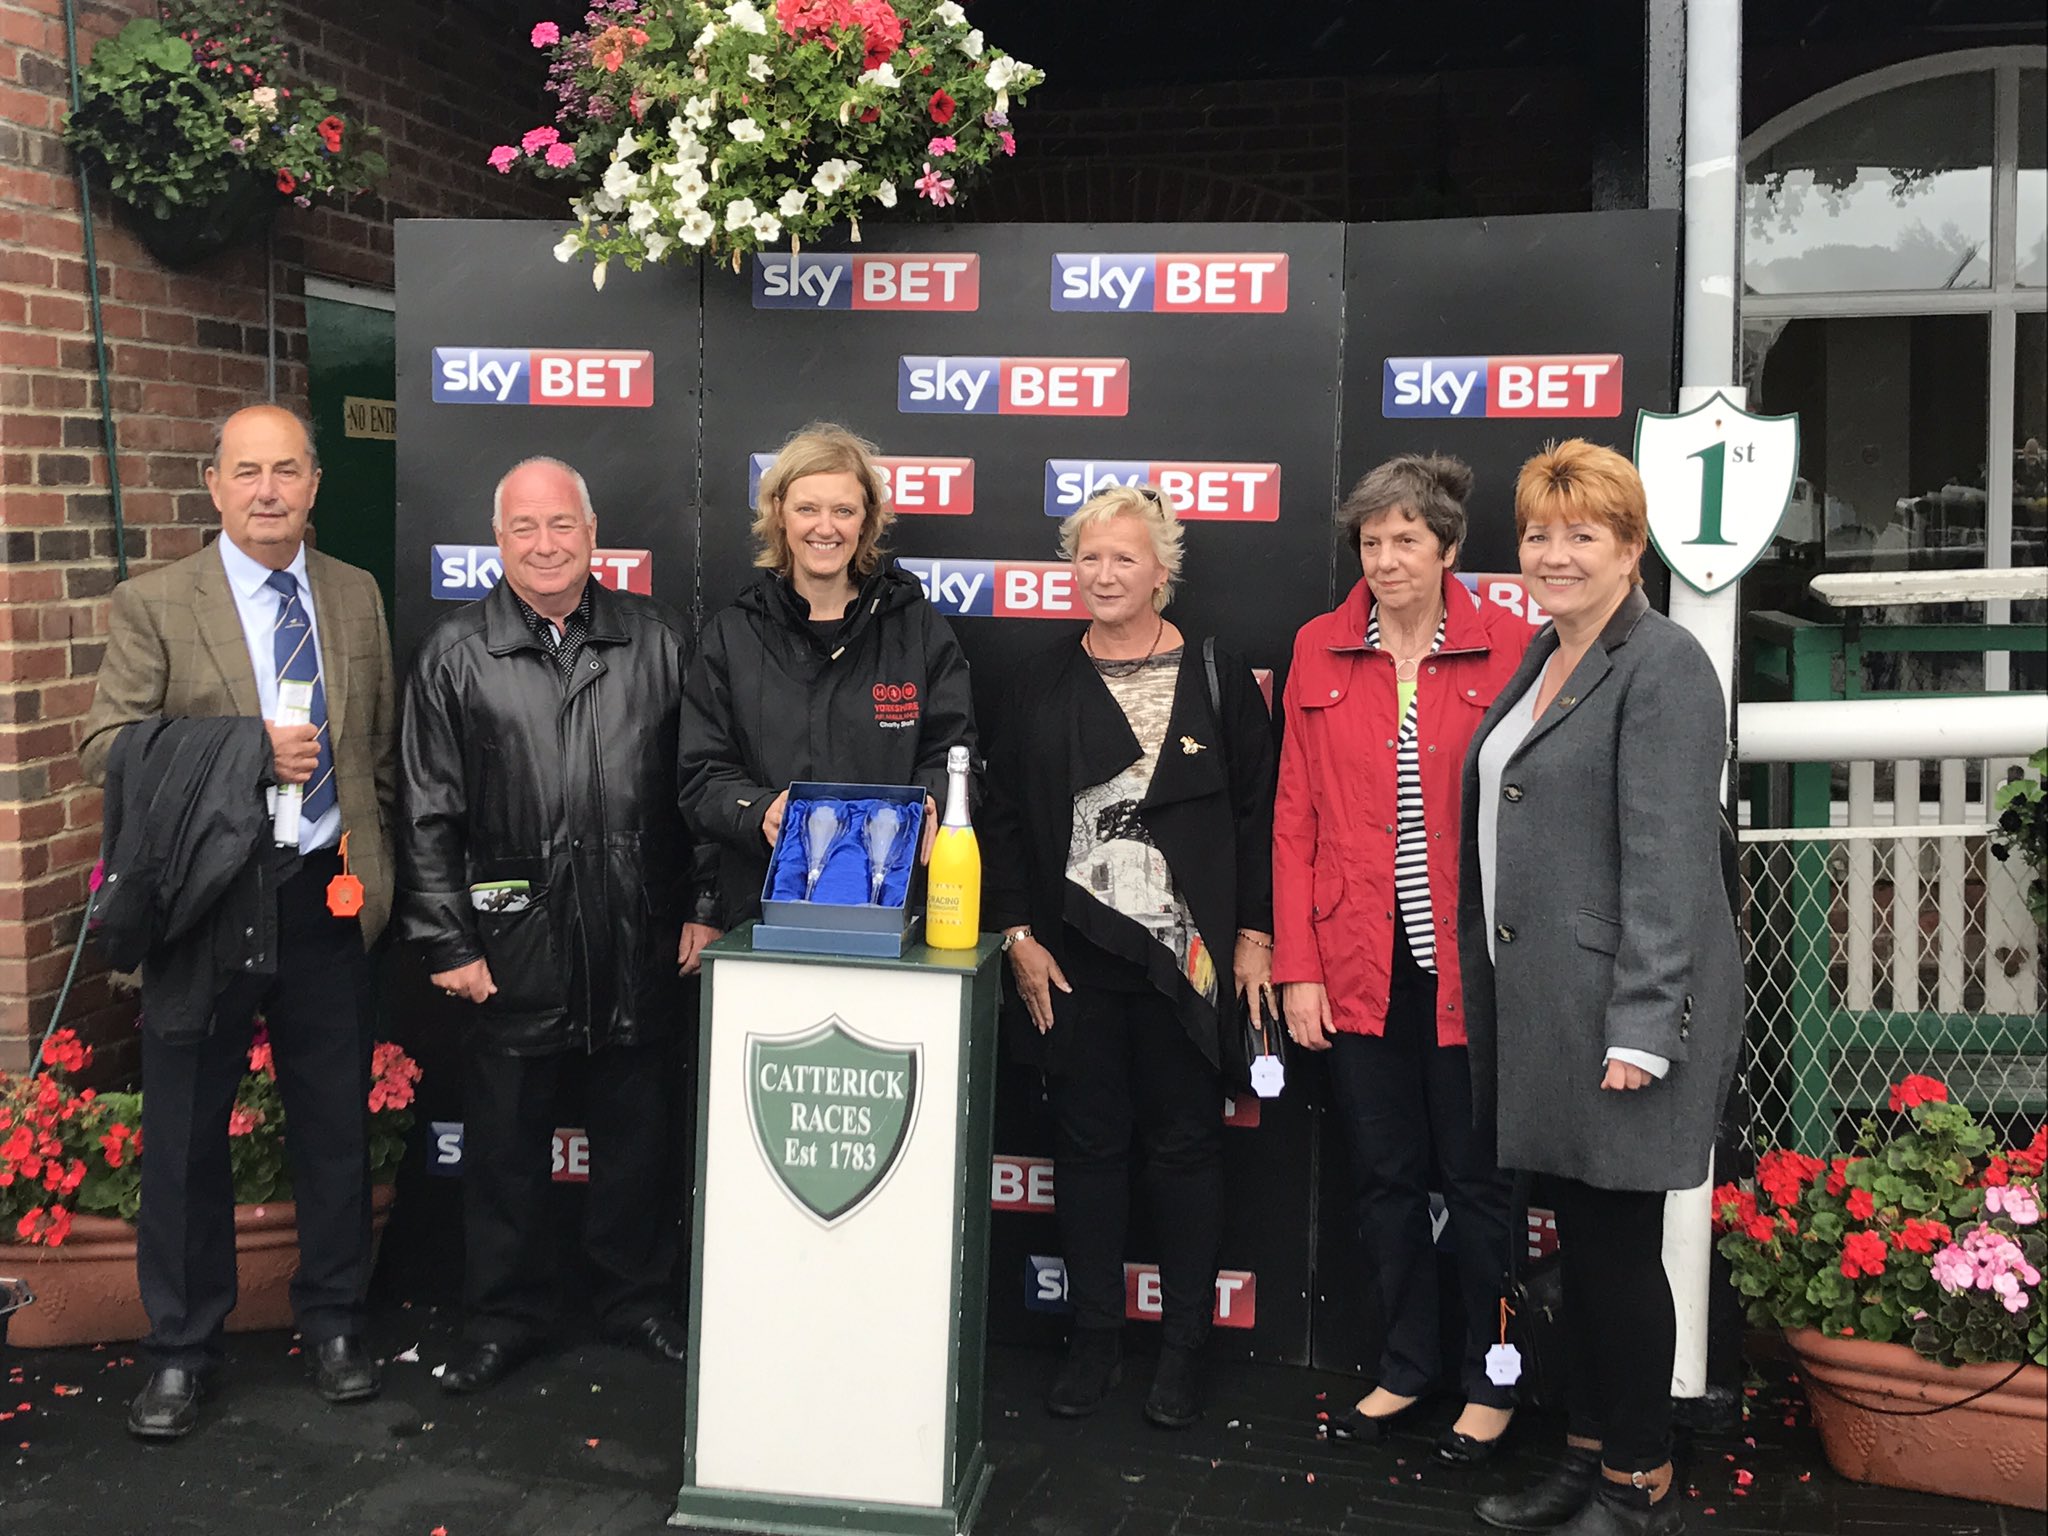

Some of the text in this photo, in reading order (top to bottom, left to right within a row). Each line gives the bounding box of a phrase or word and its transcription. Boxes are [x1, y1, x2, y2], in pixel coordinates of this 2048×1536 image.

[763, 256, 967, 307] sky BET
[1062, 256, 1276, 309] sky BET
[442, 350, 642, 402] sky BET
[909, 359, 1117, 411] sky BET
[1393, 360, 1610, 415] sky BET
[349, 404, 397, 434] NO ENTR
[1160, 470, 1268, 513] BET
[1681, 440, 1756, 546] 1st
[1004, 569, 1073, 611] BE
[760, 1062, 904, 1100] CATTERICK
[790, 1102, 871, 1136] RACES
[784, 1137, 876, 1172] Est 1783
[991, 1162, 1055, 1205] BE
